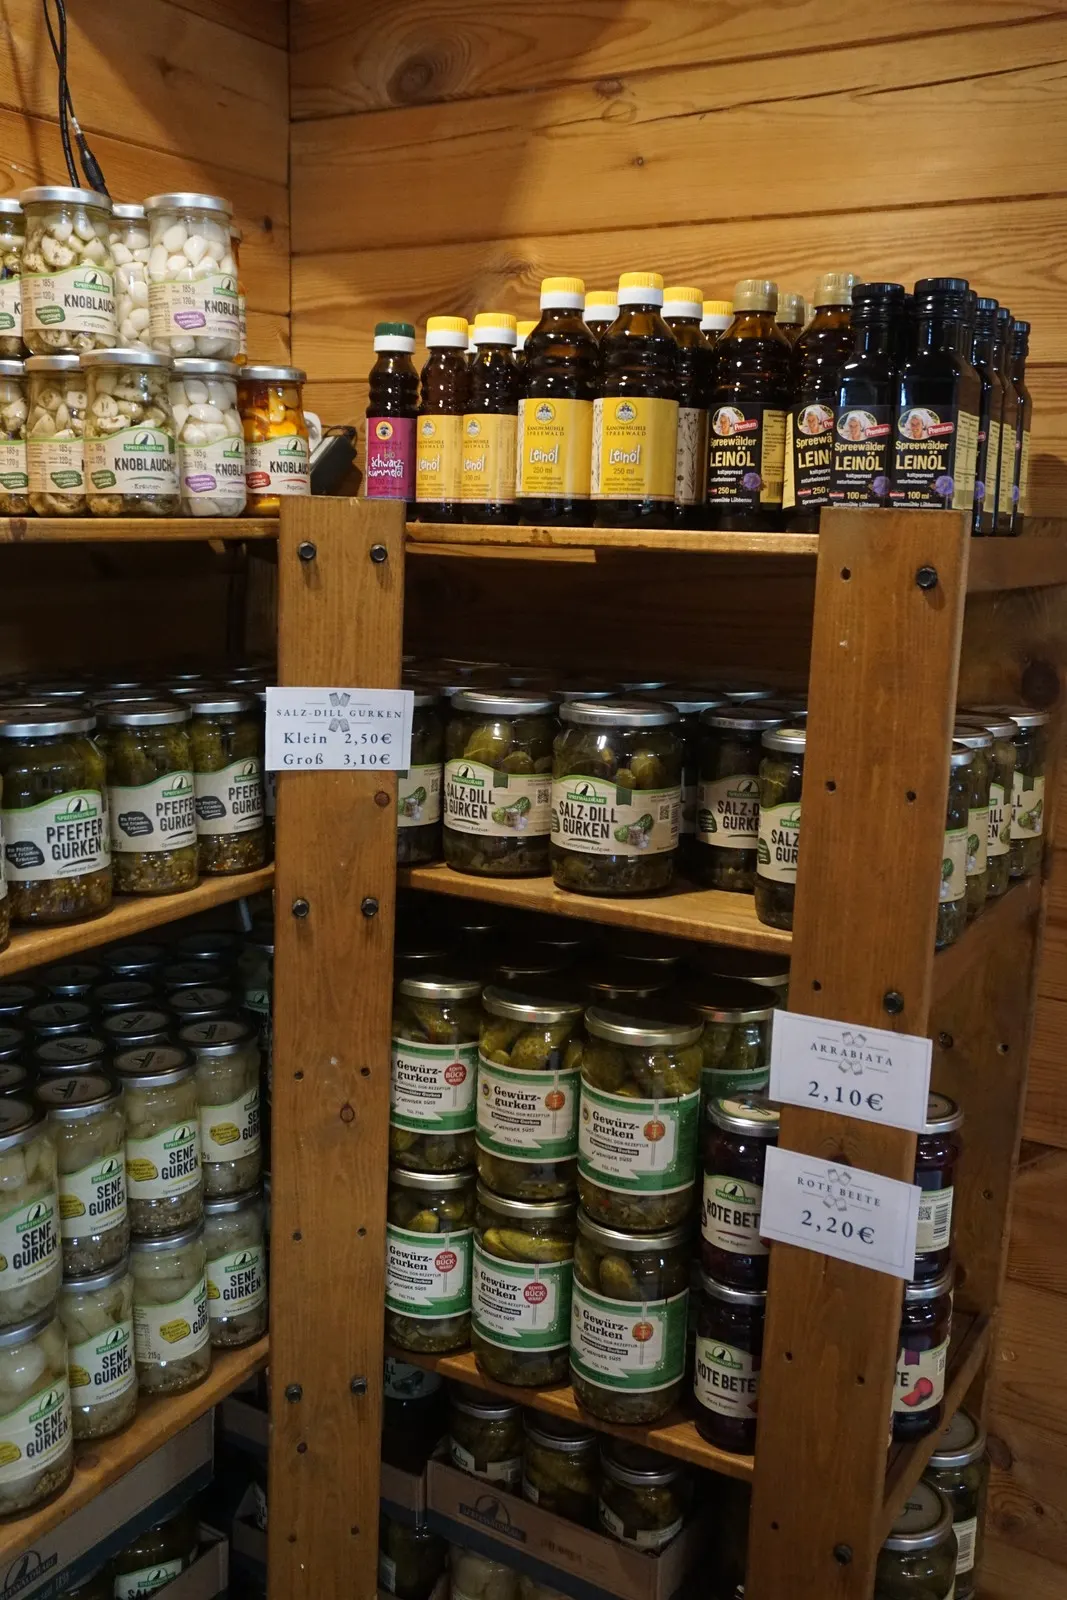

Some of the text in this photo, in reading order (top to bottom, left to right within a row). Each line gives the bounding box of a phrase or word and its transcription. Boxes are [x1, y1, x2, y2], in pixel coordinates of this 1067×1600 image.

[734, 421, 757, 431] Premium
[866, 426, 889, 436] Premium
[928, 424, 953, 435] Premium
[529, 443, 559, 464] Leinöl
[609, 444, 640, 465] Leinöl
[834, 441, 886, 452] Spreewälder
[895, 440, 949, 451] Spreewälder
[114, 457, 171, 472] KNOBLAUCH
[710, 446, 755, 467] LEINÖL
[798, 448, 832, 469] LEIN
[835, 452, 883, 471] LEINÖL
[895, 451, 946, 470] LEINÖL
[813, 487, 825, 495] 250
[276, 709, 402, 718] SALZ-DILL GURKEN
[283, 732, 392, 745] Klein 2,50€
[283, 753, 391, 766] Groß 3,10€
[449, 799, 488, 820] GURKEN
[46, 818, 102, 843] PFEFFER
[563, 818, 610, 839] GURKEN
[51, 836, 102, 860] GURKEN
[810, 1042, 893, 1067] ARRABIATA
[396, 1060, 442, 1075] Gewürz-
[397, 1071, 438, 1084] gurken
[494, 1085, 541, 1101] Gewürz-
[808, 1080, 884, 1112] 2,10€
[495, 1097, 536, 1110] gurken
[592, 1110, 640, 1130] Gewürz-
[593, 1123, 634, 1140] gurken
[169, 1144, 194, 1164] SENF
[97, 1176, 121, 1200] SENF
[797, 1176, 881, 1207] ROTE BEETE
[706, 1198, 732, 1224] ROTE
[22, 1220, 52, 1249] SENF
[801, 1210, 875, 1245] 2,20€
[13, 1232, 57, 1270] GURKEN
[389, 1245, 433, 1262] Gewürz-
[390, 1256, 428, 1270] gurken
[230, 1267, 256, 1287] SENF
[480, 1271, 521, 1291] Gewürz-
[223, 1276, 261, 1301] GURKEN
[480, 1282, 516, 1301] gurken
[583, 1309, 628, 1331] Gewürz-
[583, 1321, 623, 1340] gurken
[102, 1345, 128, 1369] SENF
[94, 1354, 132, 1385] GURKEN
[721, 1374, 757, 1393] BETE
[35, 1406, 63, 1437] SENF
[26, 1416, 68, 1458] GURKEN
